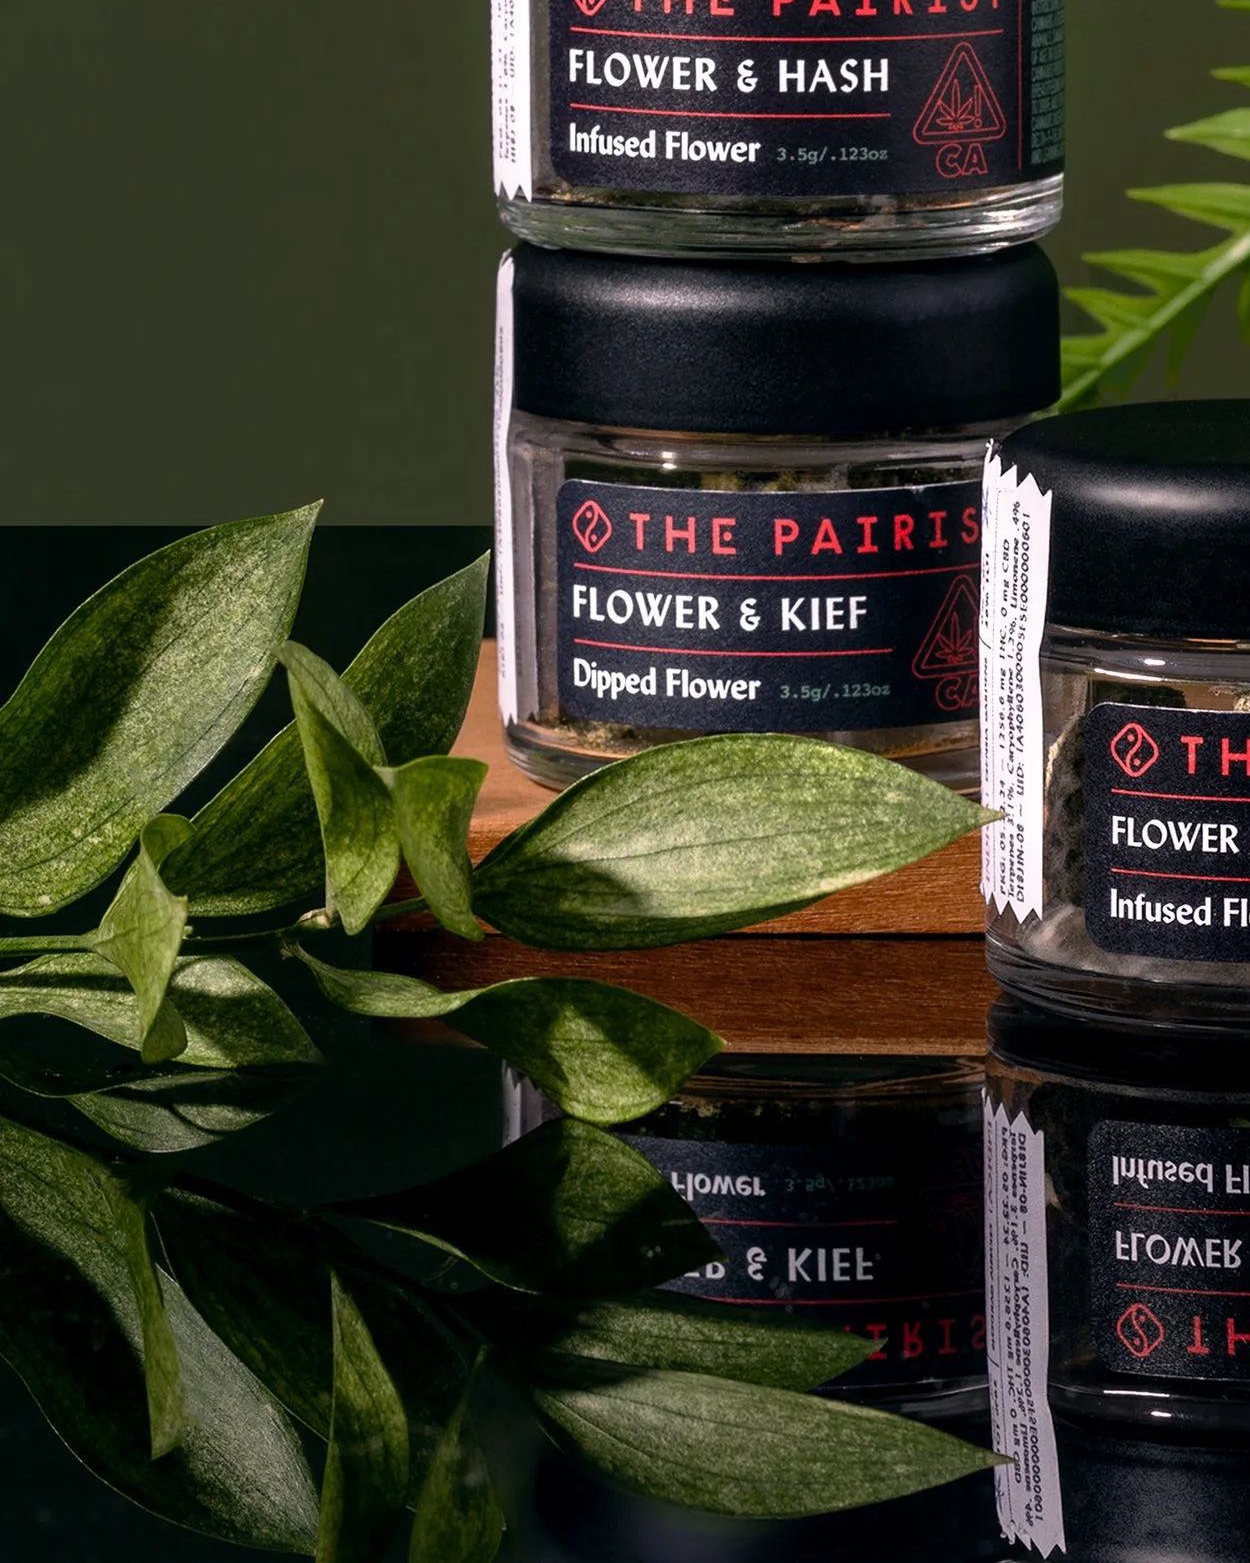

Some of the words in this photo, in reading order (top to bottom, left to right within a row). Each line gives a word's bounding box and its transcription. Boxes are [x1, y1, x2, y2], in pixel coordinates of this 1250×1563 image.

[569, 48, 718, 92] FLOWER
[737, 59, 759, 93] &
[778, 58, 889, 93] HASH
[569, 122, 656, 159] Infused
[665, 130, 762, 163] Flower
[776, 146, 888, 165] 3.5g/.123oz
[935, 141, 989, 179] CA
[629, 512, 737, 555] THE
[774, 508, 978, 556] PAIRIS
[1002, 539, 1010, 573] CBD
[1010, 537, 1019, 609] Limonene
[573, 584, 721, 631] FLOWER
[739, 597, 761, 632] &
[781, 596, 867, 631] KIEF
[573, 657, 657, 700] Dipped
[665, 667, 762, 701] Flower
[779, 683, 890, 702] 3.5g/.123oz
[1007, 668, 1015, 775] Caryophyllene
[1112, 815, 1240, 854] FLOWER
[1110, 888, 1212, 926] Infused
